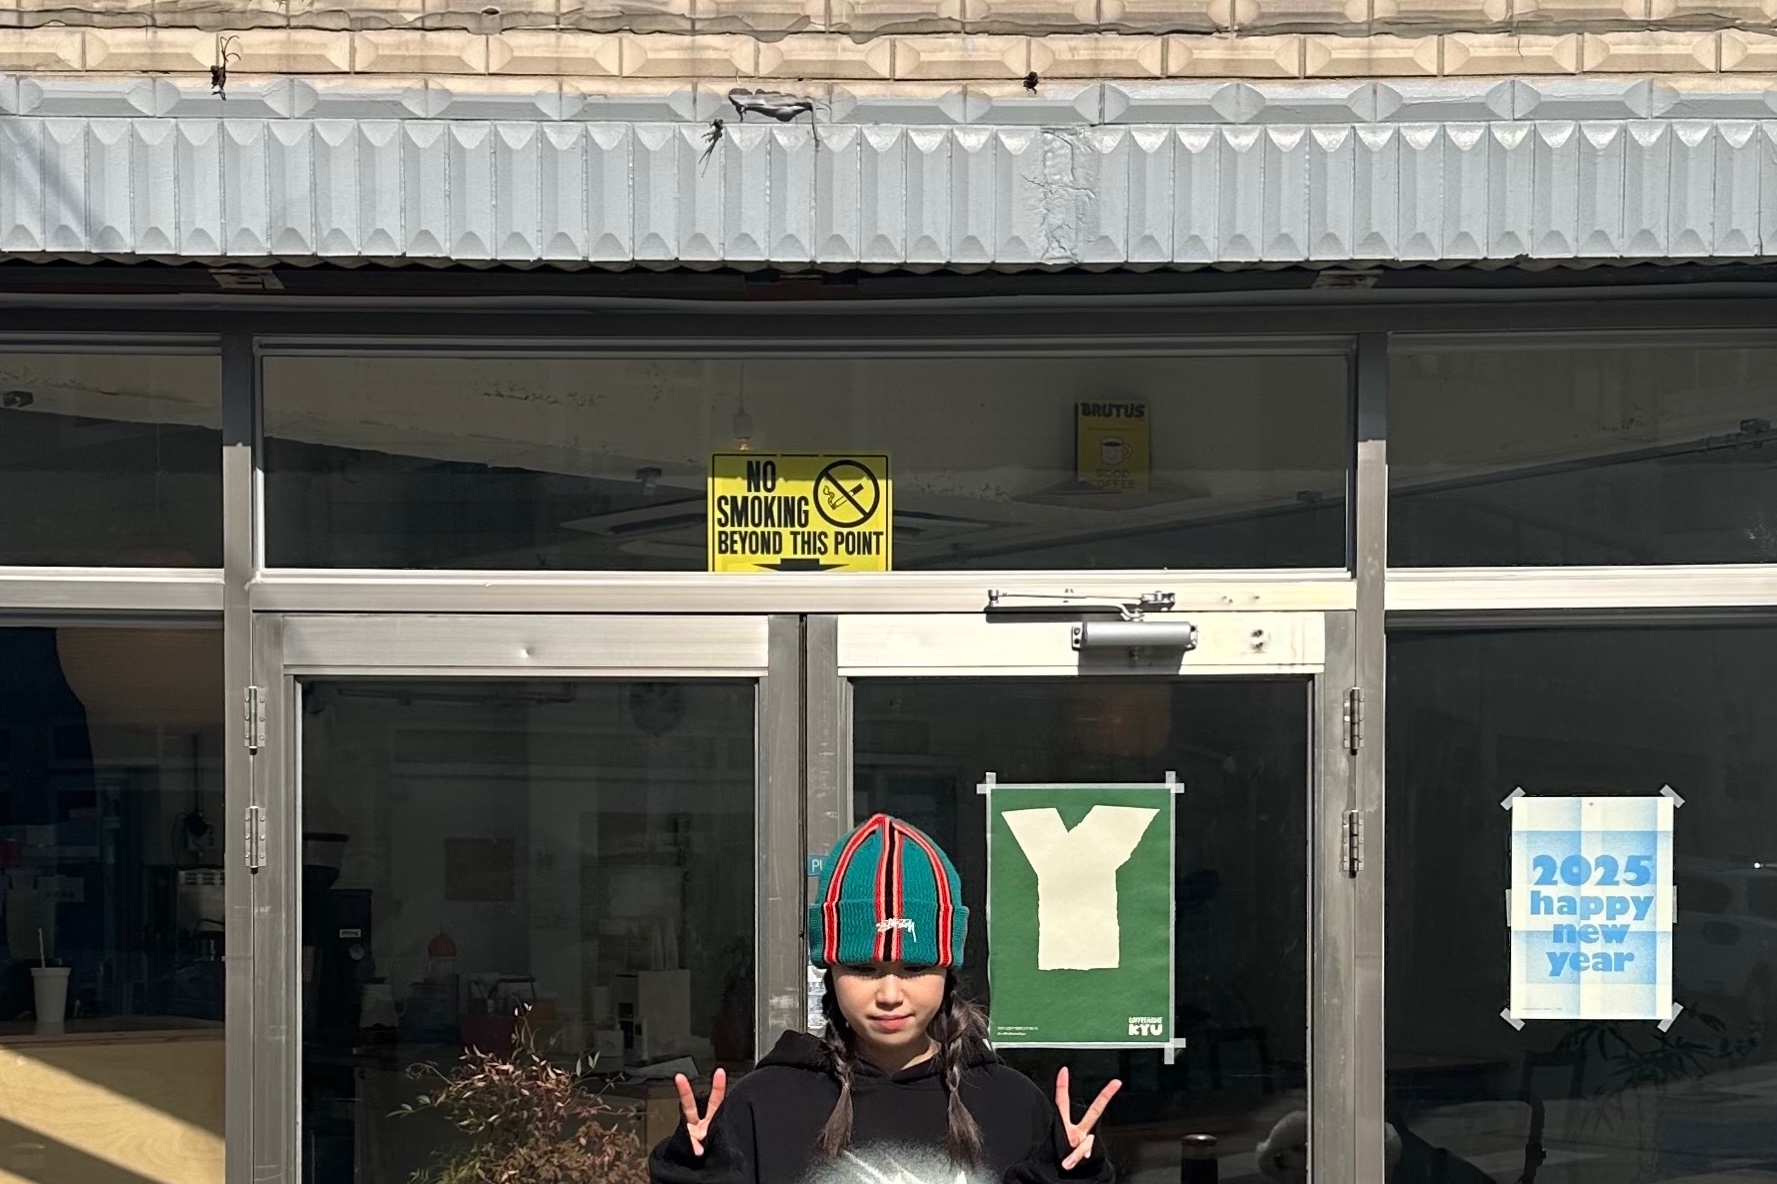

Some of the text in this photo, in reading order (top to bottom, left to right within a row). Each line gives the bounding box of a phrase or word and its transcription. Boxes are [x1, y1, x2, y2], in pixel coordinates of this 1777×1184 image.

[1080, 402, 1146, 419] BRUTUS
[747, 460, 776, 493] NO
[717, 495, 809, 528] SMOKING
[717, 531, 884, 556] BEYOND THIS POINT
[1532, 854, 1653, 887] 2025
[1001, 804, 1160, 971] Y
[1530, 890, 1655, 921] happy
[1552, 923, 1631, 944] new
[1546, 951, 1635, 977] year
[1128, 1023, 1163, 1036] KYU
